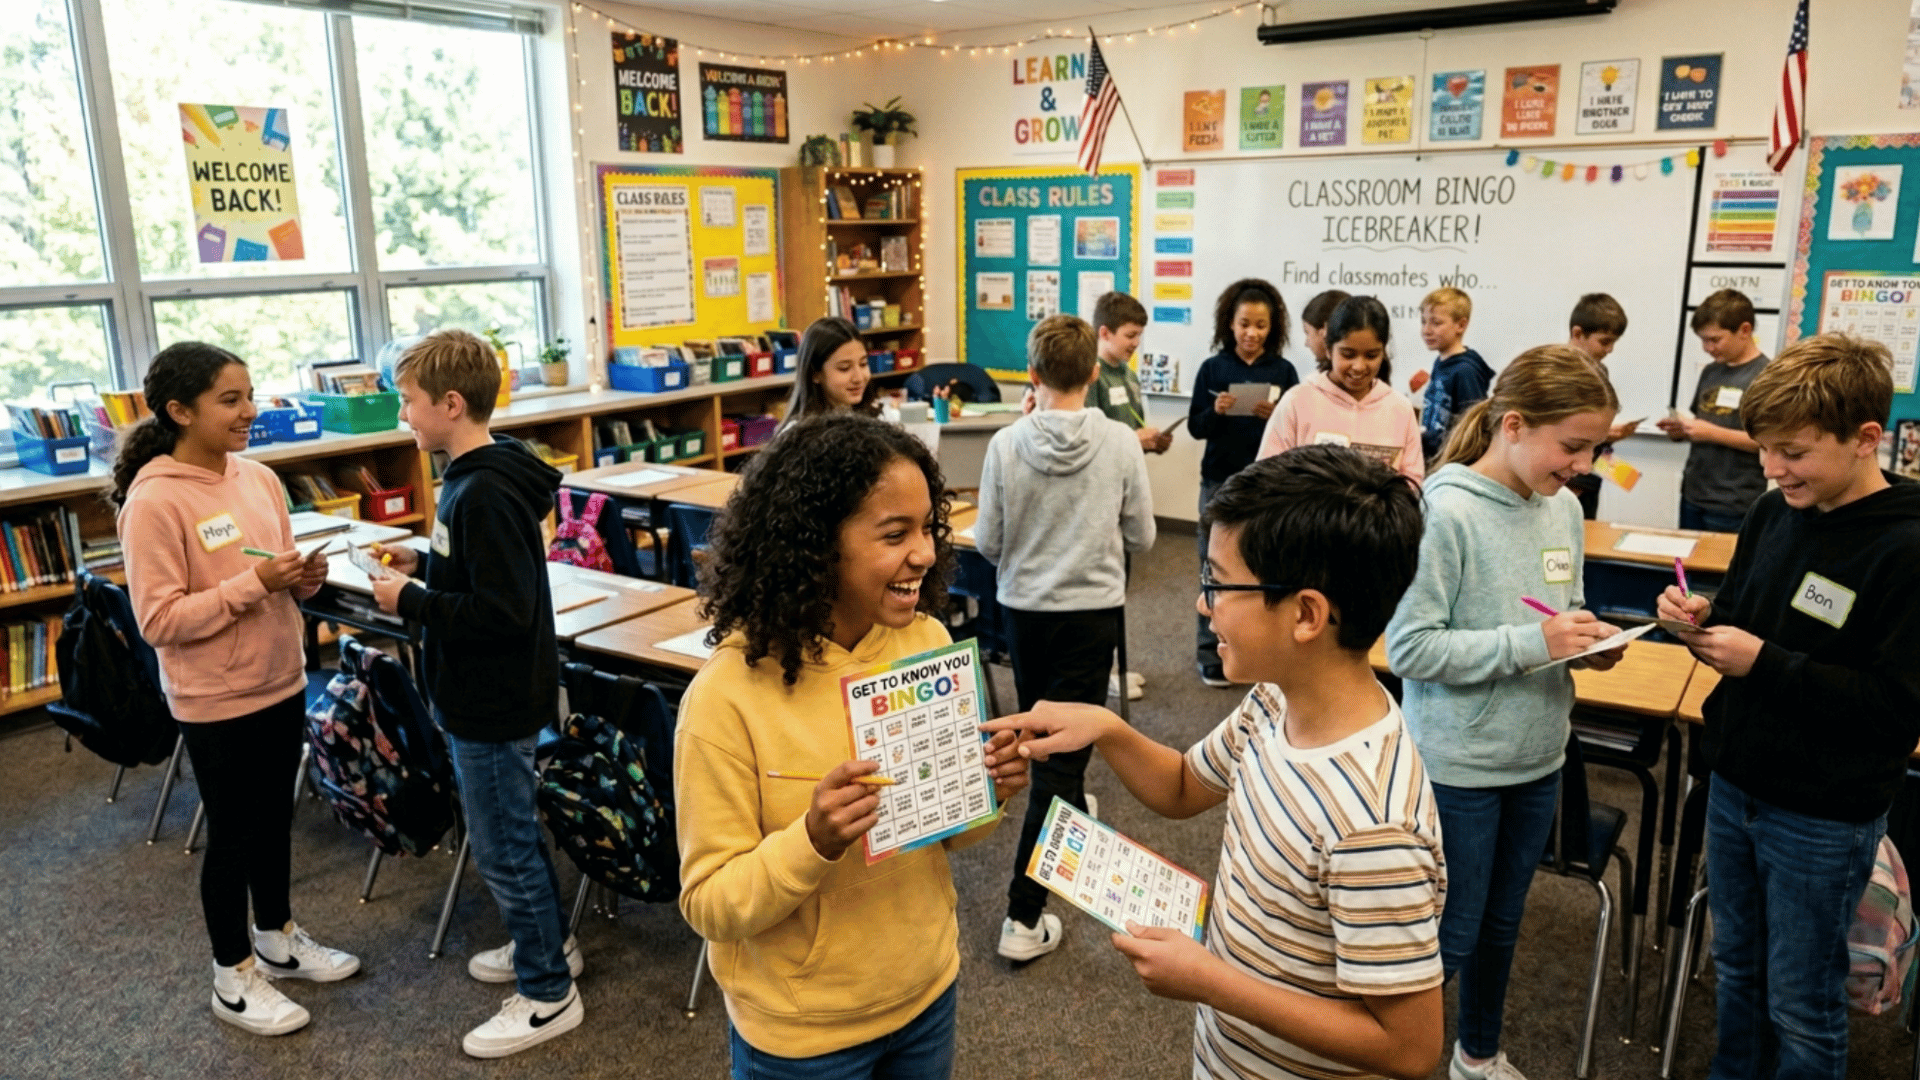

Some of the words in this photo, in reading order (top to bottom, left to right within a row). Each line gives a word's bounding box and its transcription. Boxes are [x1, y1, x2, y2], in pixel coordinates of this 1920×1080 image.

[1013, 53, 1085, 85] LEARN
[620, 89, 677, 118] BACK!
[1040, 86, 1057, 111] &
[1015, 115, 1081, 144] GROW
[193, 161, 291, 183] WELCOME
[211, 188, 282, 213] BACK!
[979, 186, 1040, 208] CLASS
[1048, 184, 1114, 207] RULES
[1289, 178, 1421, 208] CLASSROOM
[1435, 175, 1515, 206] BINGO
[1322, 214, 1481, 243] ICEBREAKER!
[1283, 261, 1320, 285] Find
[1328, 262, 1428, 288] classmates
[1439, 264, 1497, 289] who...
[1804, 584, 1833, 610] Bon
[852, 681, 877, 699] GET
[880, 675, 898, 690] TO
[901, 662, 941, 685] KNOW
[944, 654, 970, 671] YOU
